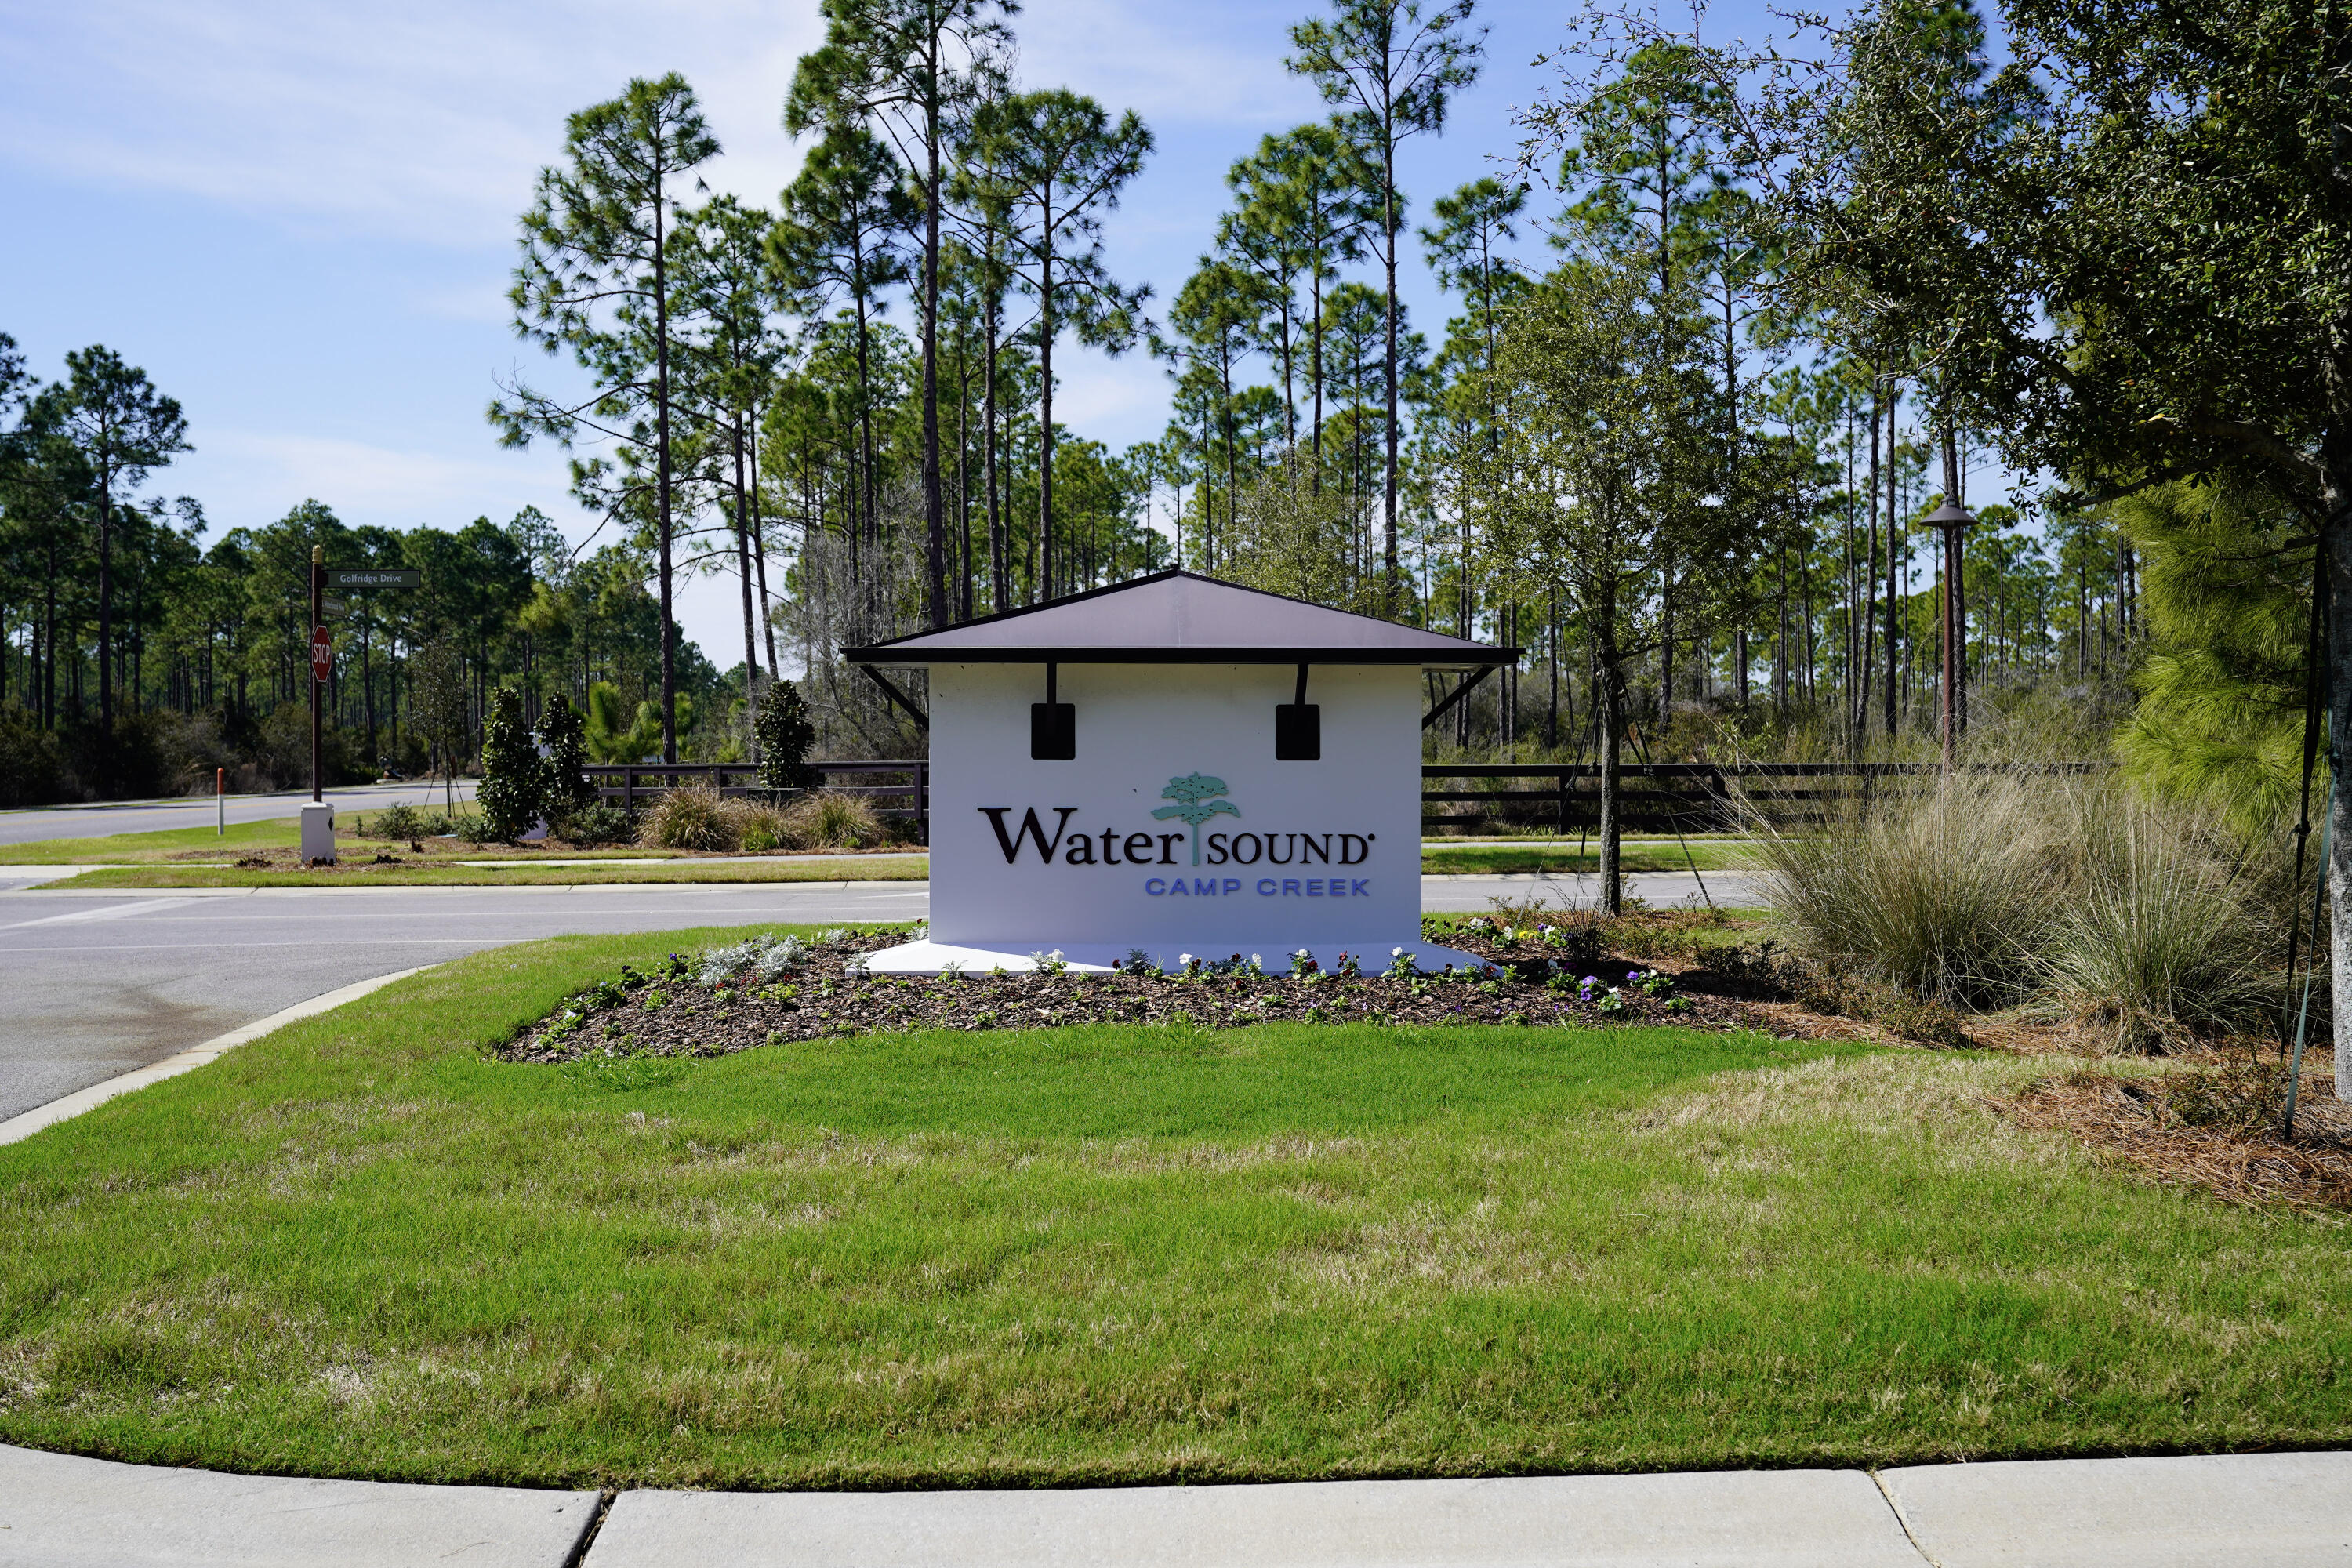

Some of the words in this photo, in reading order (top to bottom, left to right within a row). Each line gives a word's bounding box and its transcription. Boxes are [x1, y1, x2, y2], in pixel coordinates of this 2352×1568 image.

[339, 574, 378, 584] Golfridge
[380, 574, 402, 583] Drive
[313, 644, 331, 664] STOP
[1145, 877, 1242, 896] CAMP
[1256, 877, 1370, 896] CREEK
